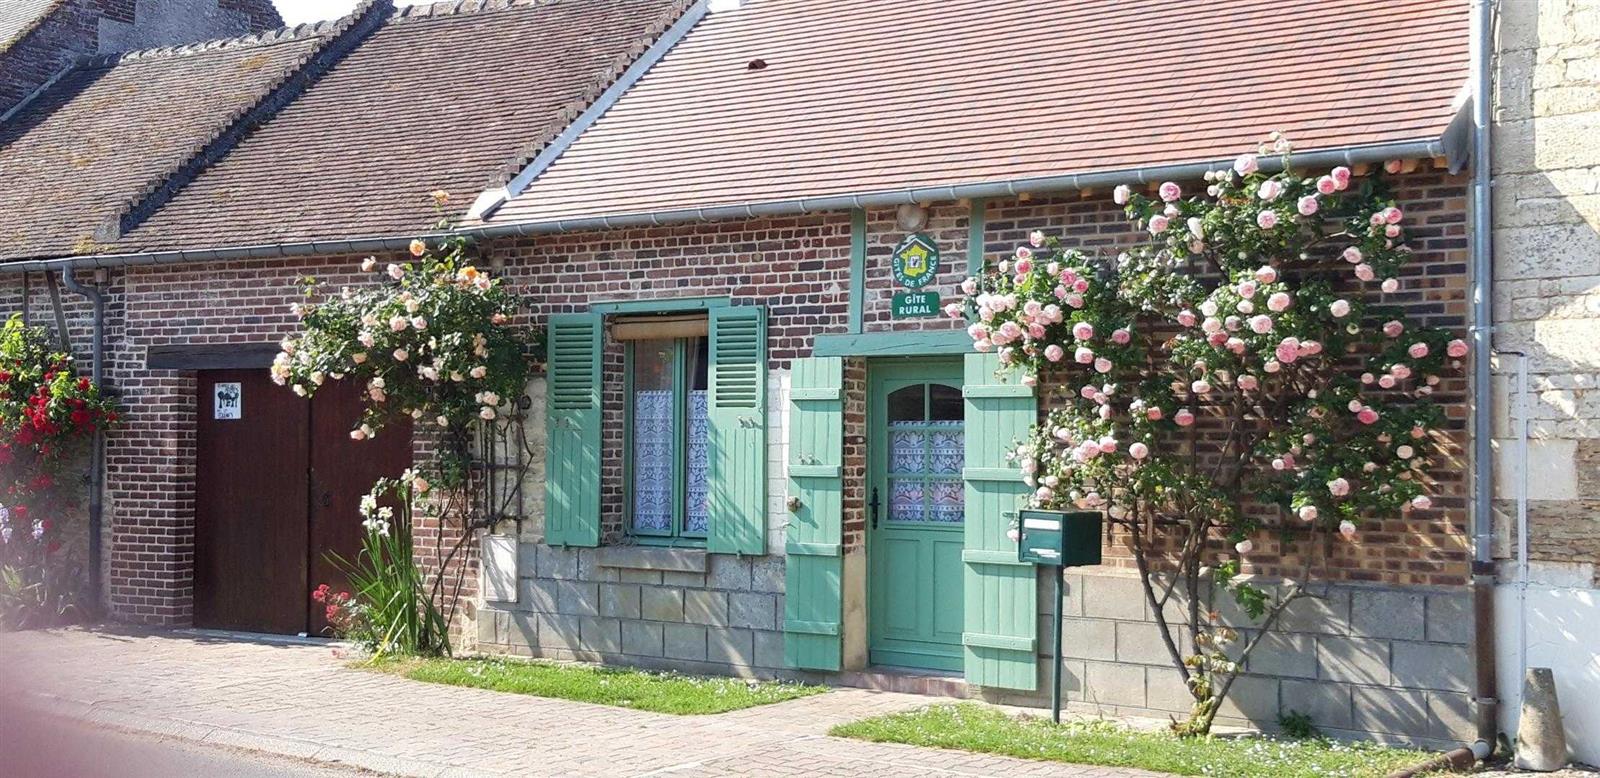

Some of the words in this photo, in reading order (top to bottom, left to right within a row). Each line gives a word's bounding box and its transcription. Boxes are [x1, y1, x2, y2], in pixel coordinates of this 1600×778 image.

[904, 279, 915, 287] DE
[918, 255, 937, 285] FRANCE
[899, 305, 931, 315] RURAL
